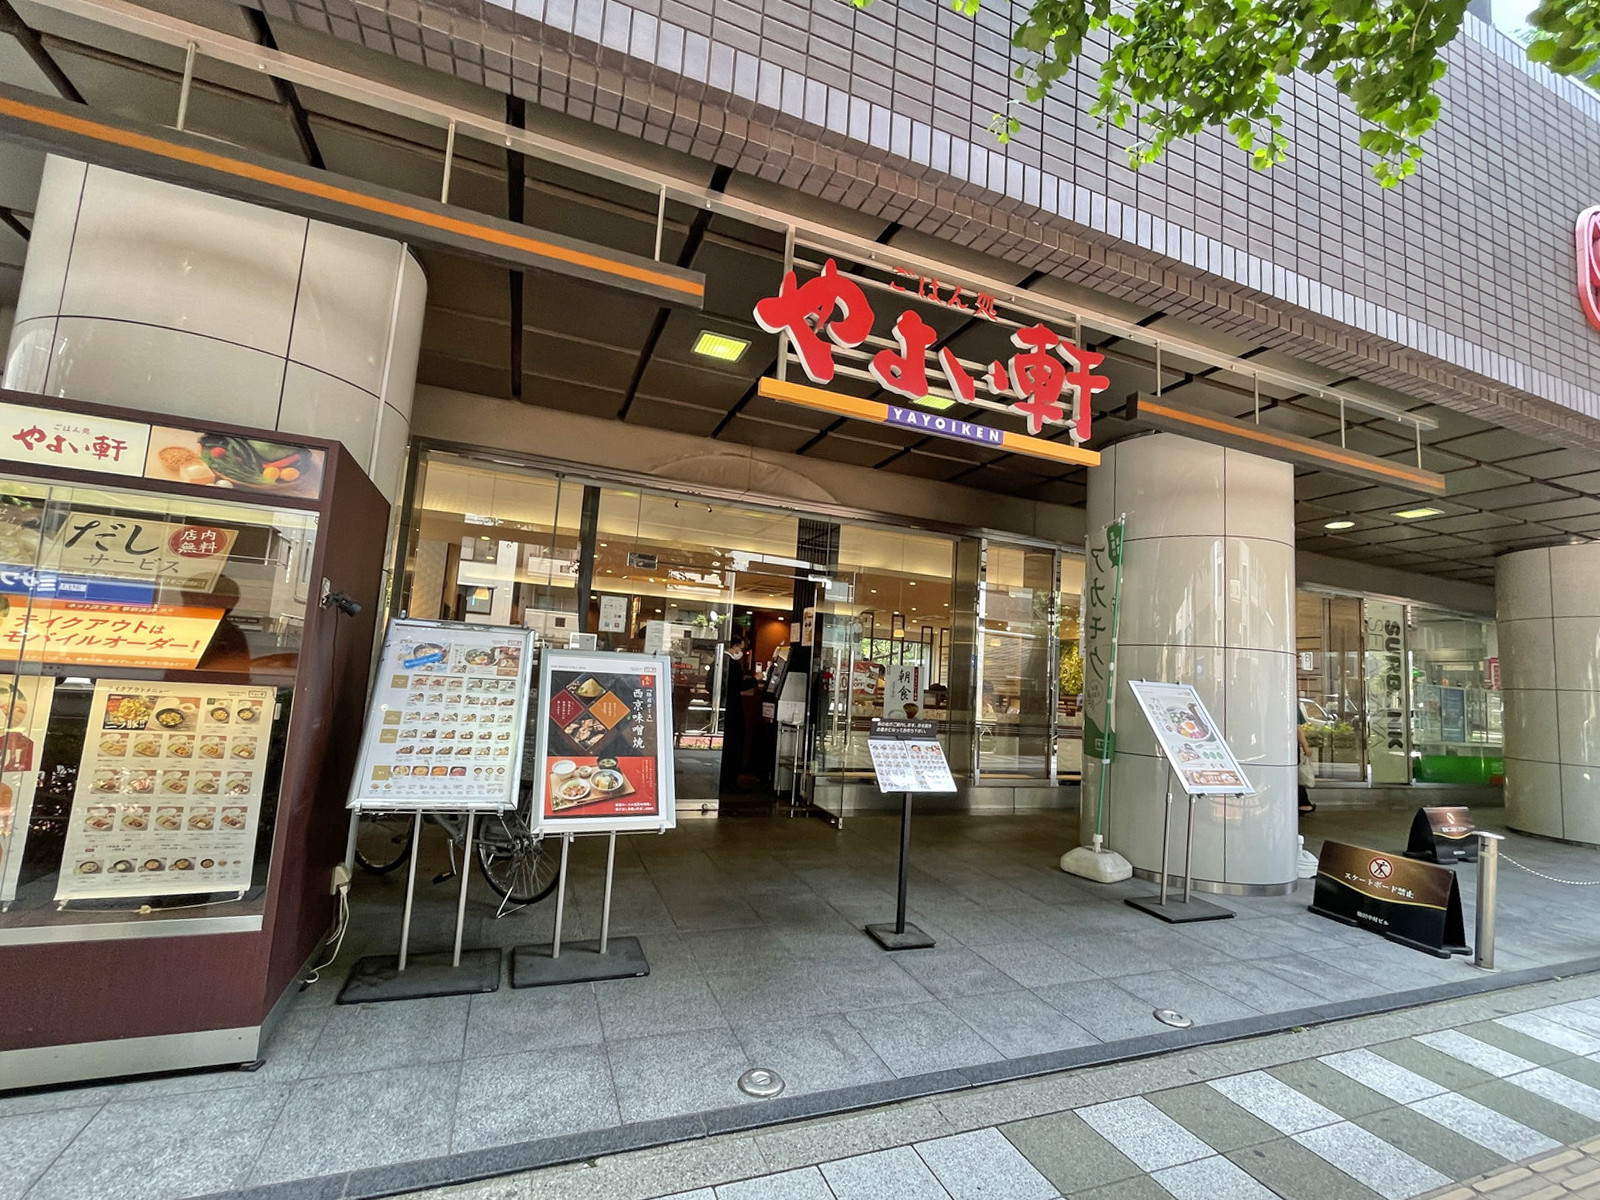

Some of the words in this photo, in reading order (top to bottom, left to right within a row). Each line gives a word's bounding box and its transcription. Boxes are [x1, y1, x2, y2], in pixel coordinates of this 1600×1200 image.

[890, 266, 997, 321] ごはん処
[753, 258, 1110, 442] やよい軒
[893, 408, 999, 442] YAYOIKEN
[12, 425, 128, 461] やよい軒
[65, 520, 159, 555] だし
[178, 541, 218, 553] 無料
[180, 529, 217, 541] 店内
[83, 553, 179, 574] サービス
[14, 614, 165, 635] テイクアウトは
[897, 668, 911, 701] 朝食
[632, 688, 645, 749] 西京味噌焼
[1344, 872, 1415, 899] スケートボード禁止
